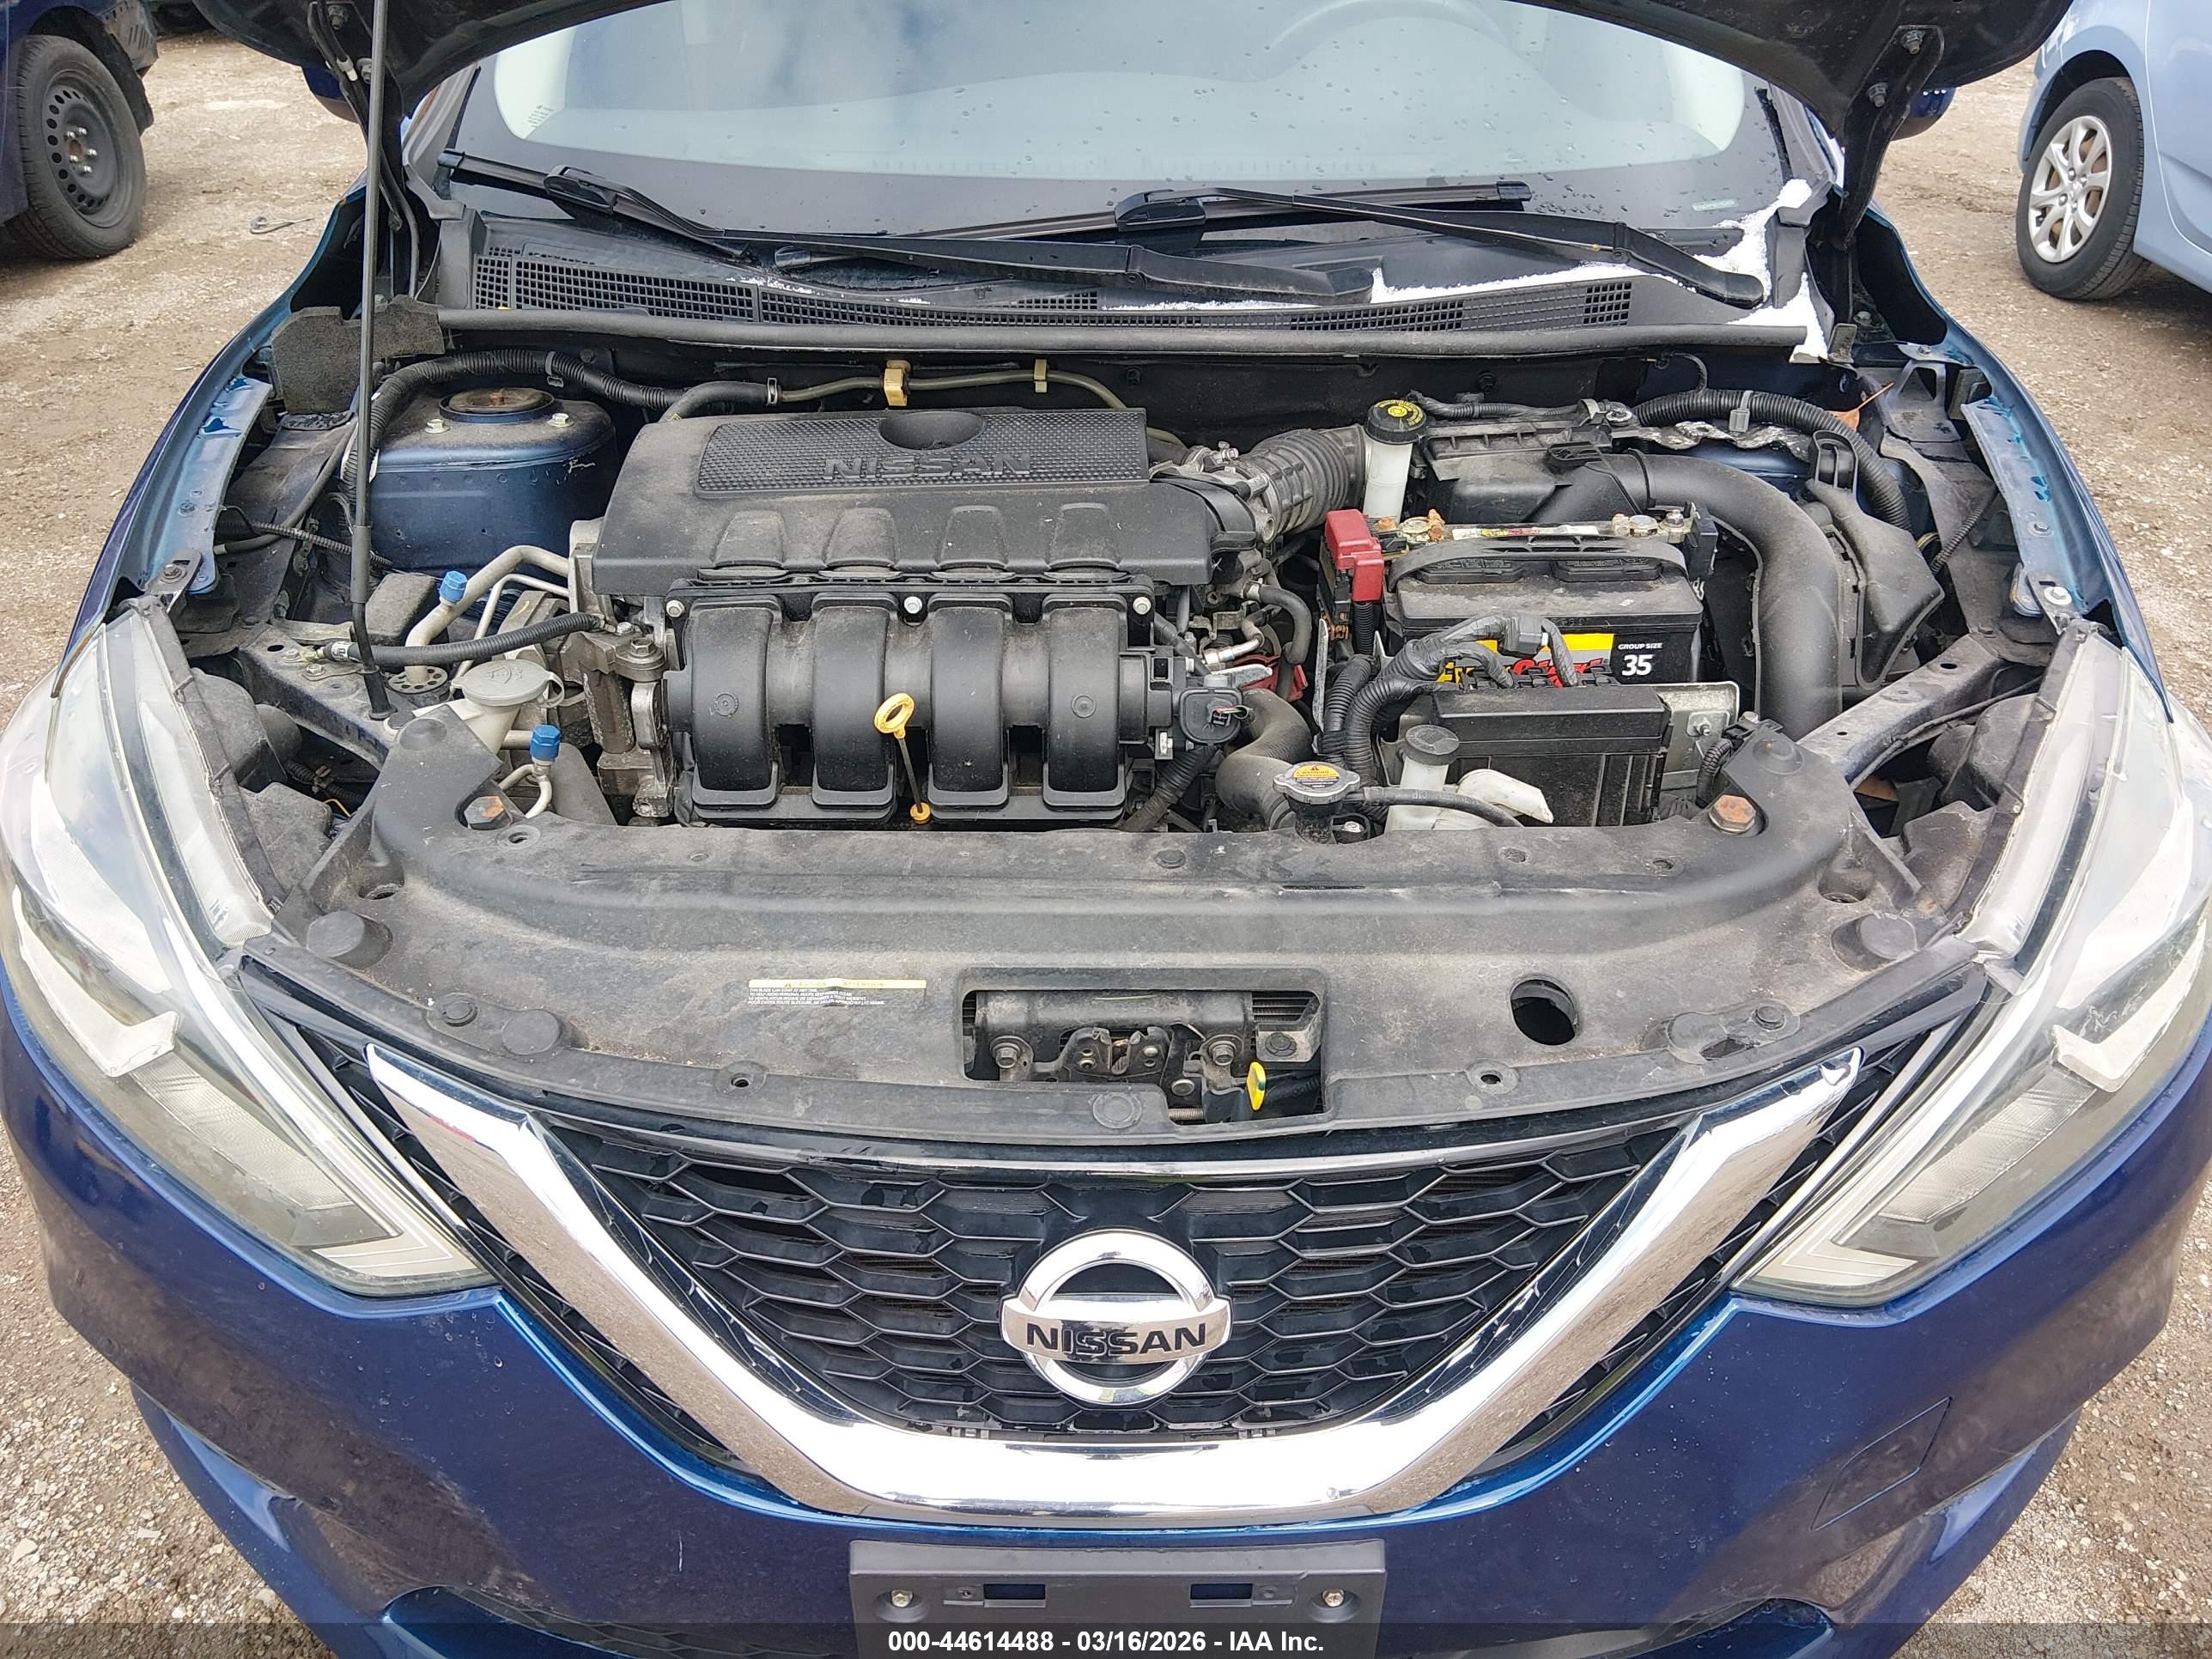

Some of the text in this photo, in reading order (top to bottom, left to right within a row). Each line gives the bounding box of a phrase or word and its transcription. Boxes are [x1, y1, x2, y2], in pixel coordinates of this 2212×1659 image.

[823, 453, 1031, 480] NISSAN
[1622, 653, 1656, 677] 35
[1027, 1322, 1206, 1356] NISSAN
